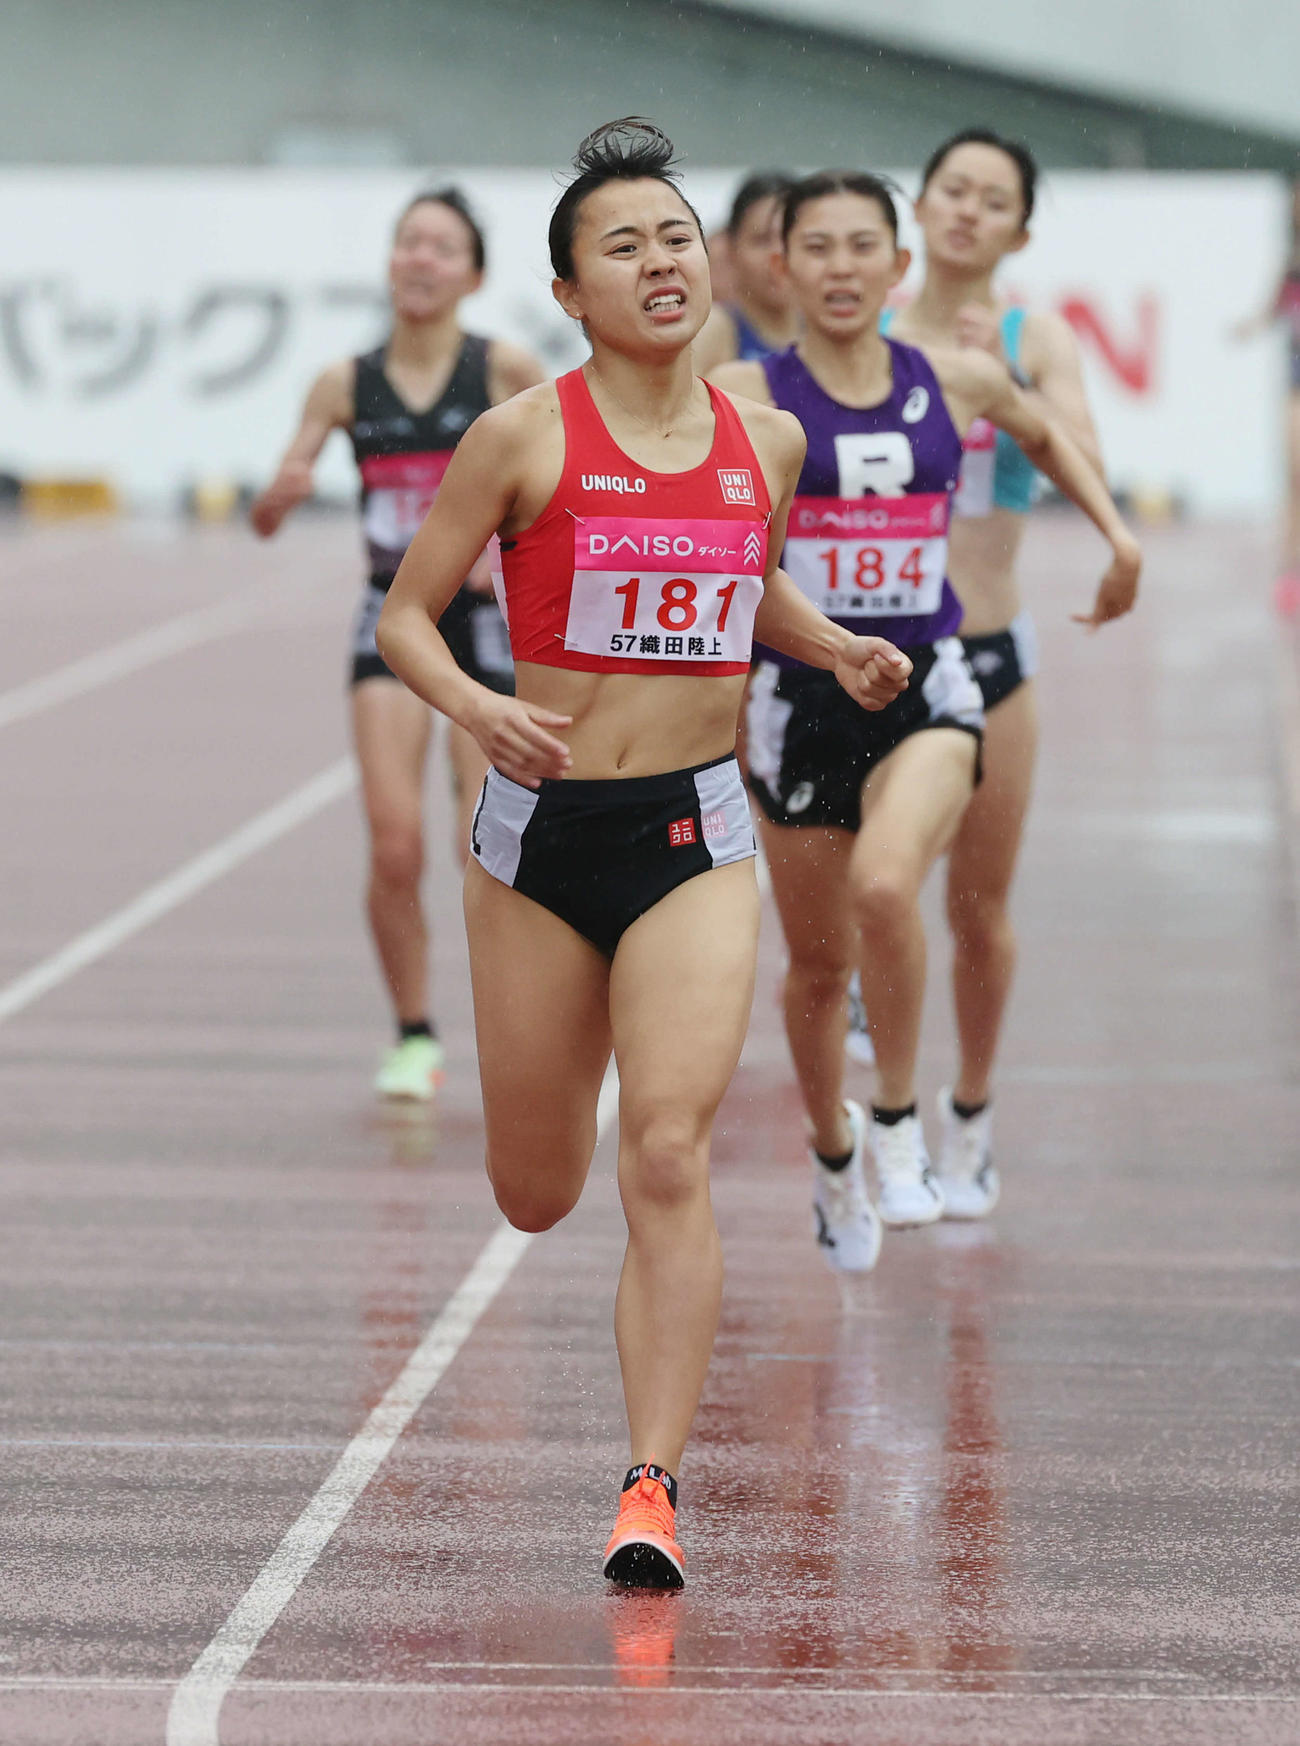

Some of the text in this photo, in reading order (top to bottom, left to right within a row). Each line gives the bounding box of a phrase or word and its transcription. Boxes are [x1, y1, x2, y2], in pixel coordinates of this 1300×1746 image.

[834, 432, 915, 500] R
[581, 474, 647, 494] UNIQLO
[723, 474, 748, 487] UNI
[727, 487, 751, 500] QLO
[589, 534, 737, 558] DAISO ダイソー
[820, 546, 924, 590] 184
[614, 577, 738, 633] 181
[609, 633, 723, 657] 57織田陸上
[703, 813, 722, 826] UNI
[704, 825, 725, 837] QLO
